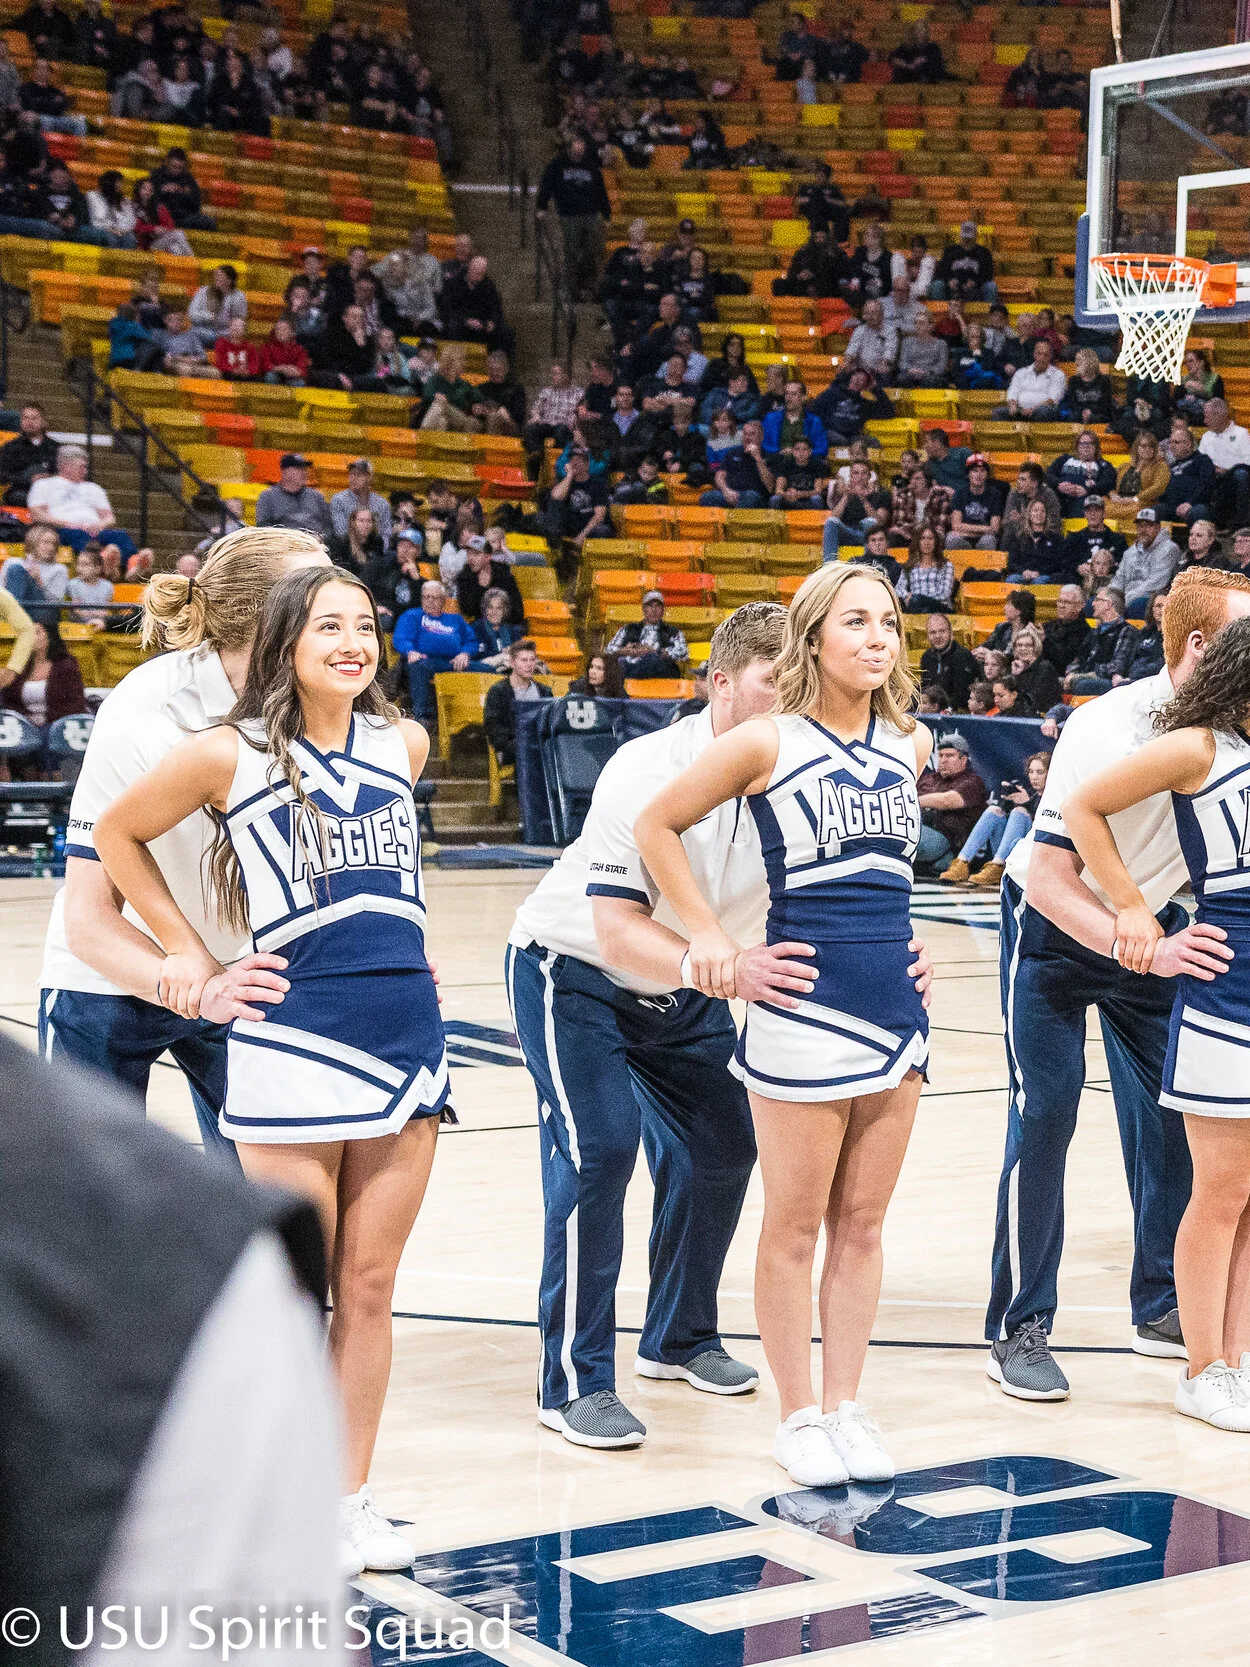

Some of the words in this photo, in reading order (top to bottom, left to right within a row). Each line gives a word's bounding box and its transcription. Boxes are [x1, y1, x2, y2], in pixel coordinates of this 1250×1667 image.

[818, 778, 920, 846] AGGIES
[1041, 809, 1057, 818] UTAH
[291, 798, 417, 883] AGGIES
[604, 864, 628, 875] STATE
